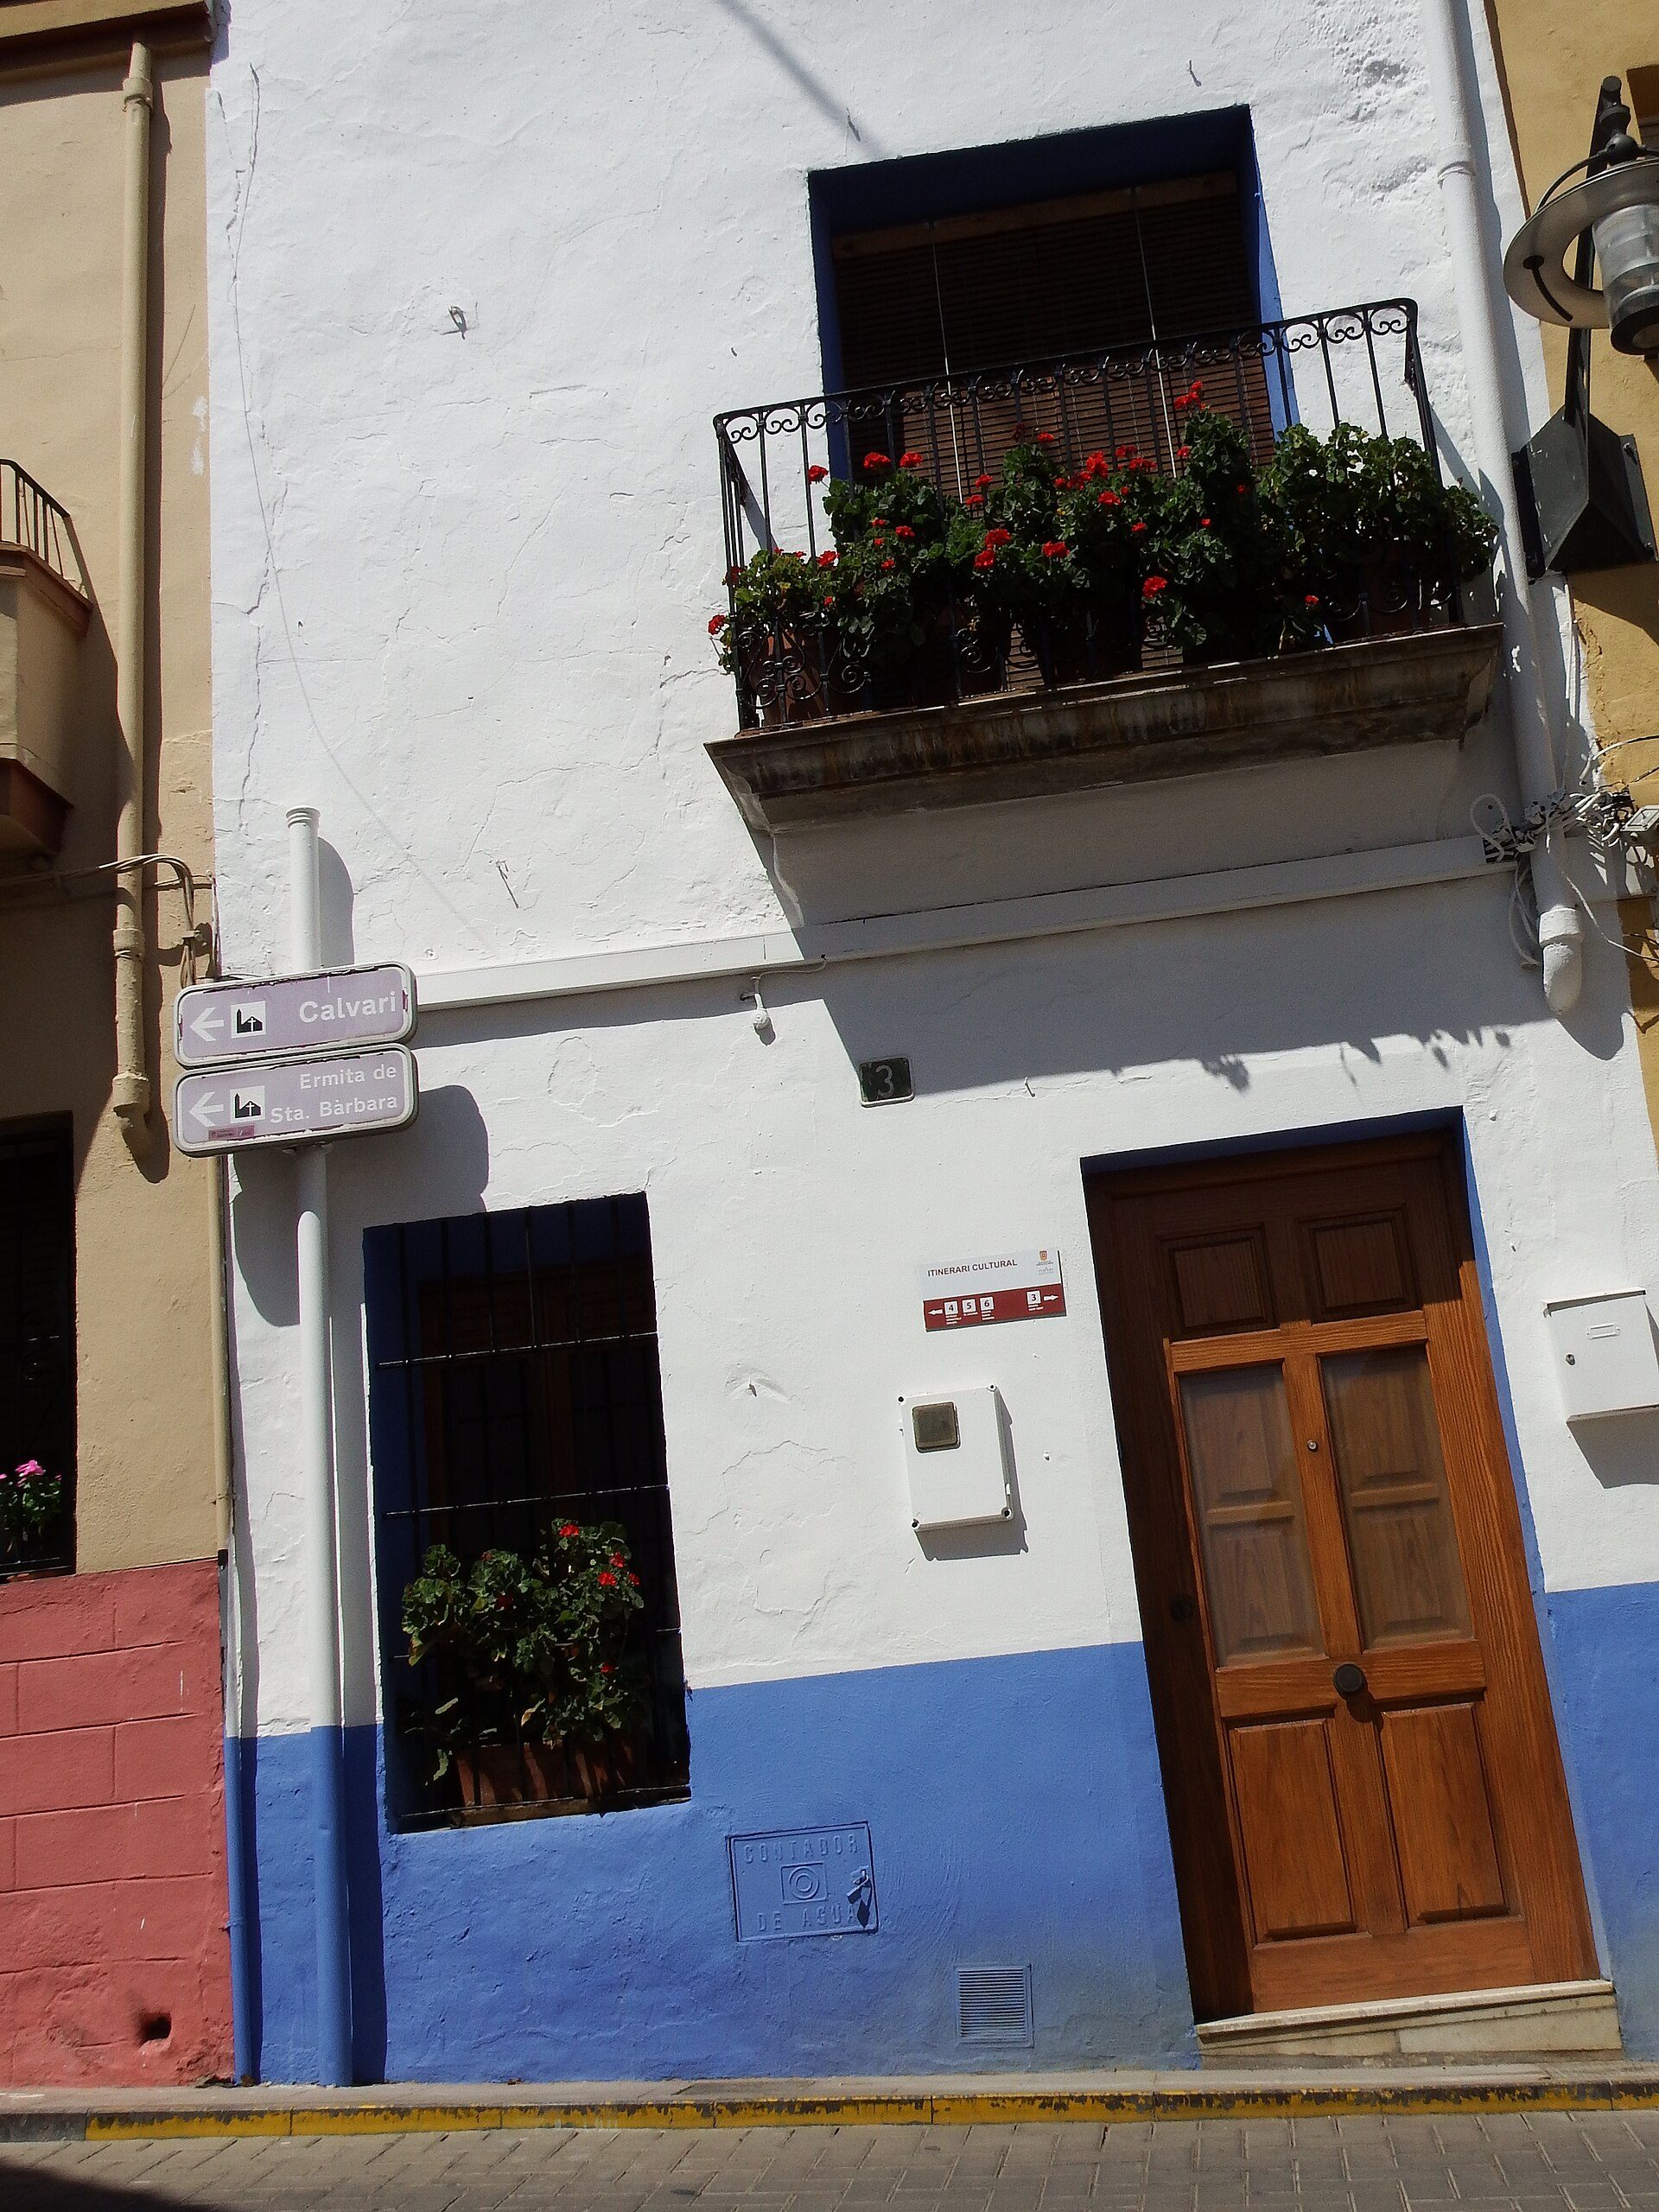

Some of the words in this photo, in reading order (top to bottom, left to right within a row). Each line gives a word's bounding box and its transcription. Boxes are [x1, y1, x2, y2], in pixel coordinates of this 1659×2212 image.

[299, 991, 396, 1023] Calvari
[300, 1069, 365, 1090] Ermita
[373, 1064, 397, 1080] de
[875, 1065, 893, 1097] 3
[270, 1107, 309, 1123] Sta.
[320, 1095, 397, 1117] Bàrbara
[928, 1265, 969, 1277] ITINERARI
[972, 1259, 1018, 1271] CULTURAL
[745, 1834, 858, 1864] CONTADOR
[758, 1910, 782, 1932] DE
